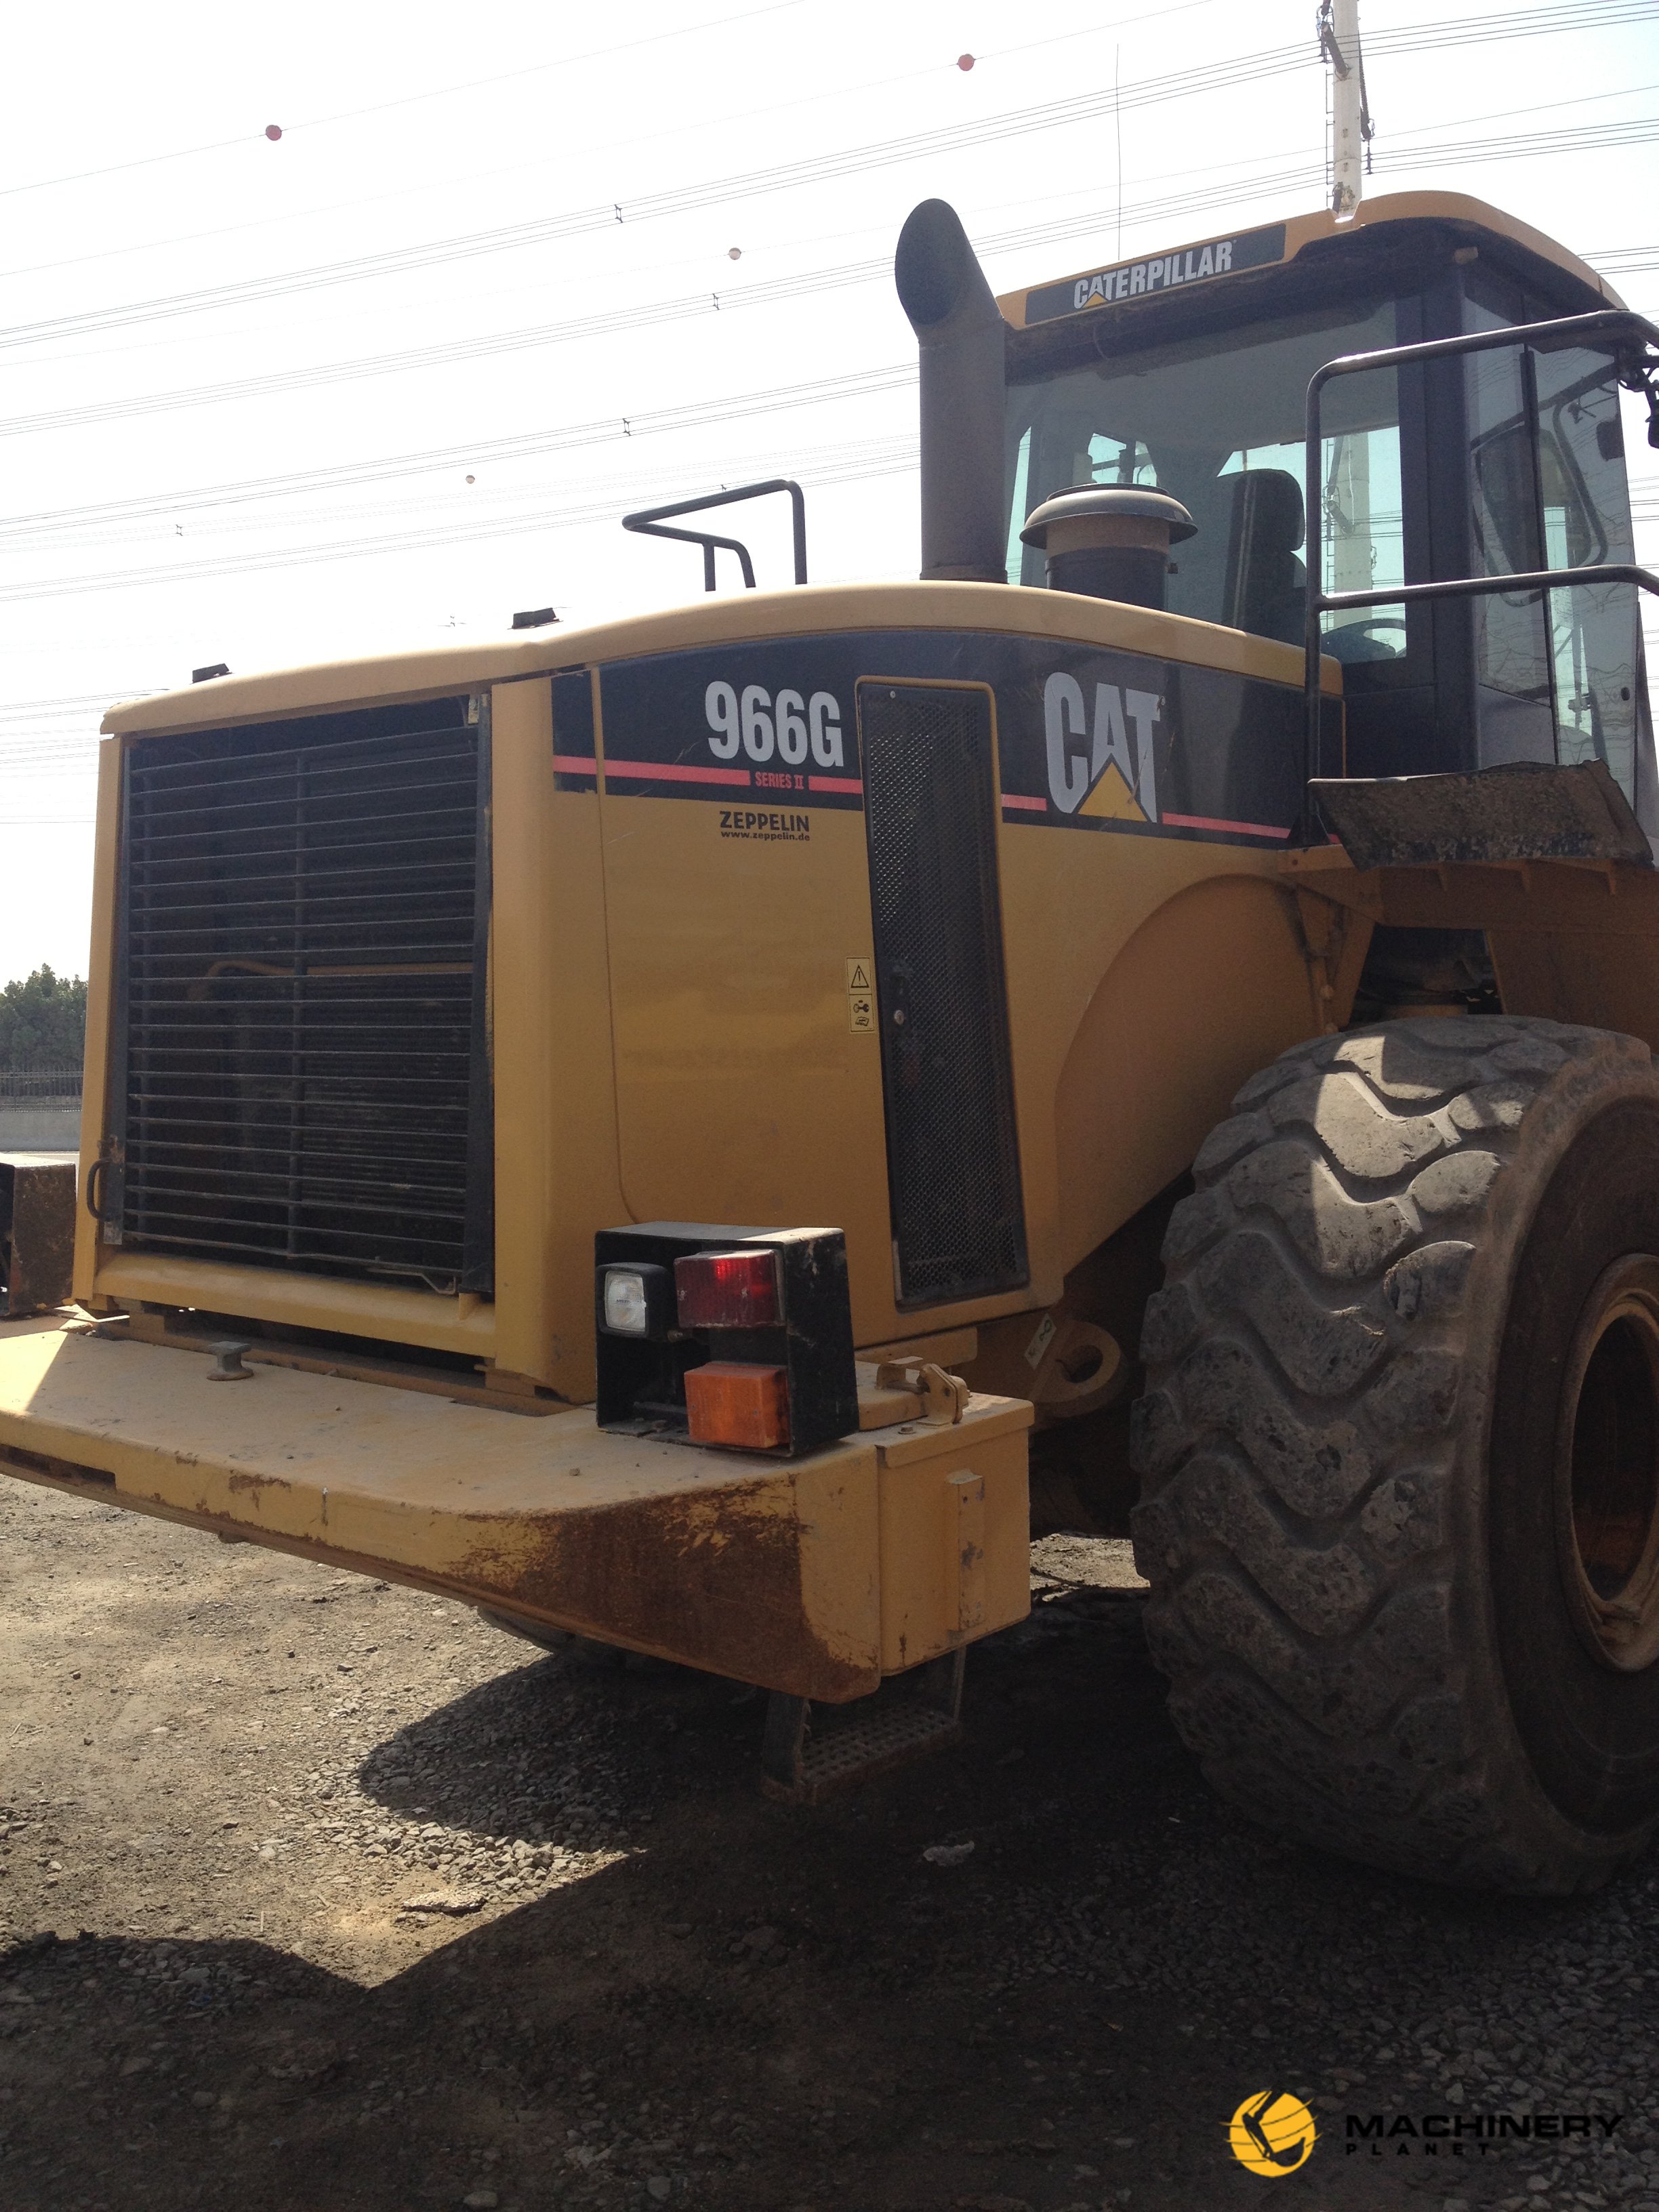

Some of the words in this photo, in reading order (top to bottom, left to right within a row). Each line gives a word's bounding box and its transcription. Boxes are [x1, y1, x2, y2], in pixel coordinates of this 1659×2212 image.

[1073, 241, 1232, 309] CATERPILLAR
[705, 680, 844, 768] 966G
[1044, 672, 1161, 823] CAT
[754, 771, 792, 789] SERIES
[794, 774, 805, 790] II
[719, 811, 810, 832] ZEPPELIN
[720, 831, 811, 841] www.zeppelin.de
